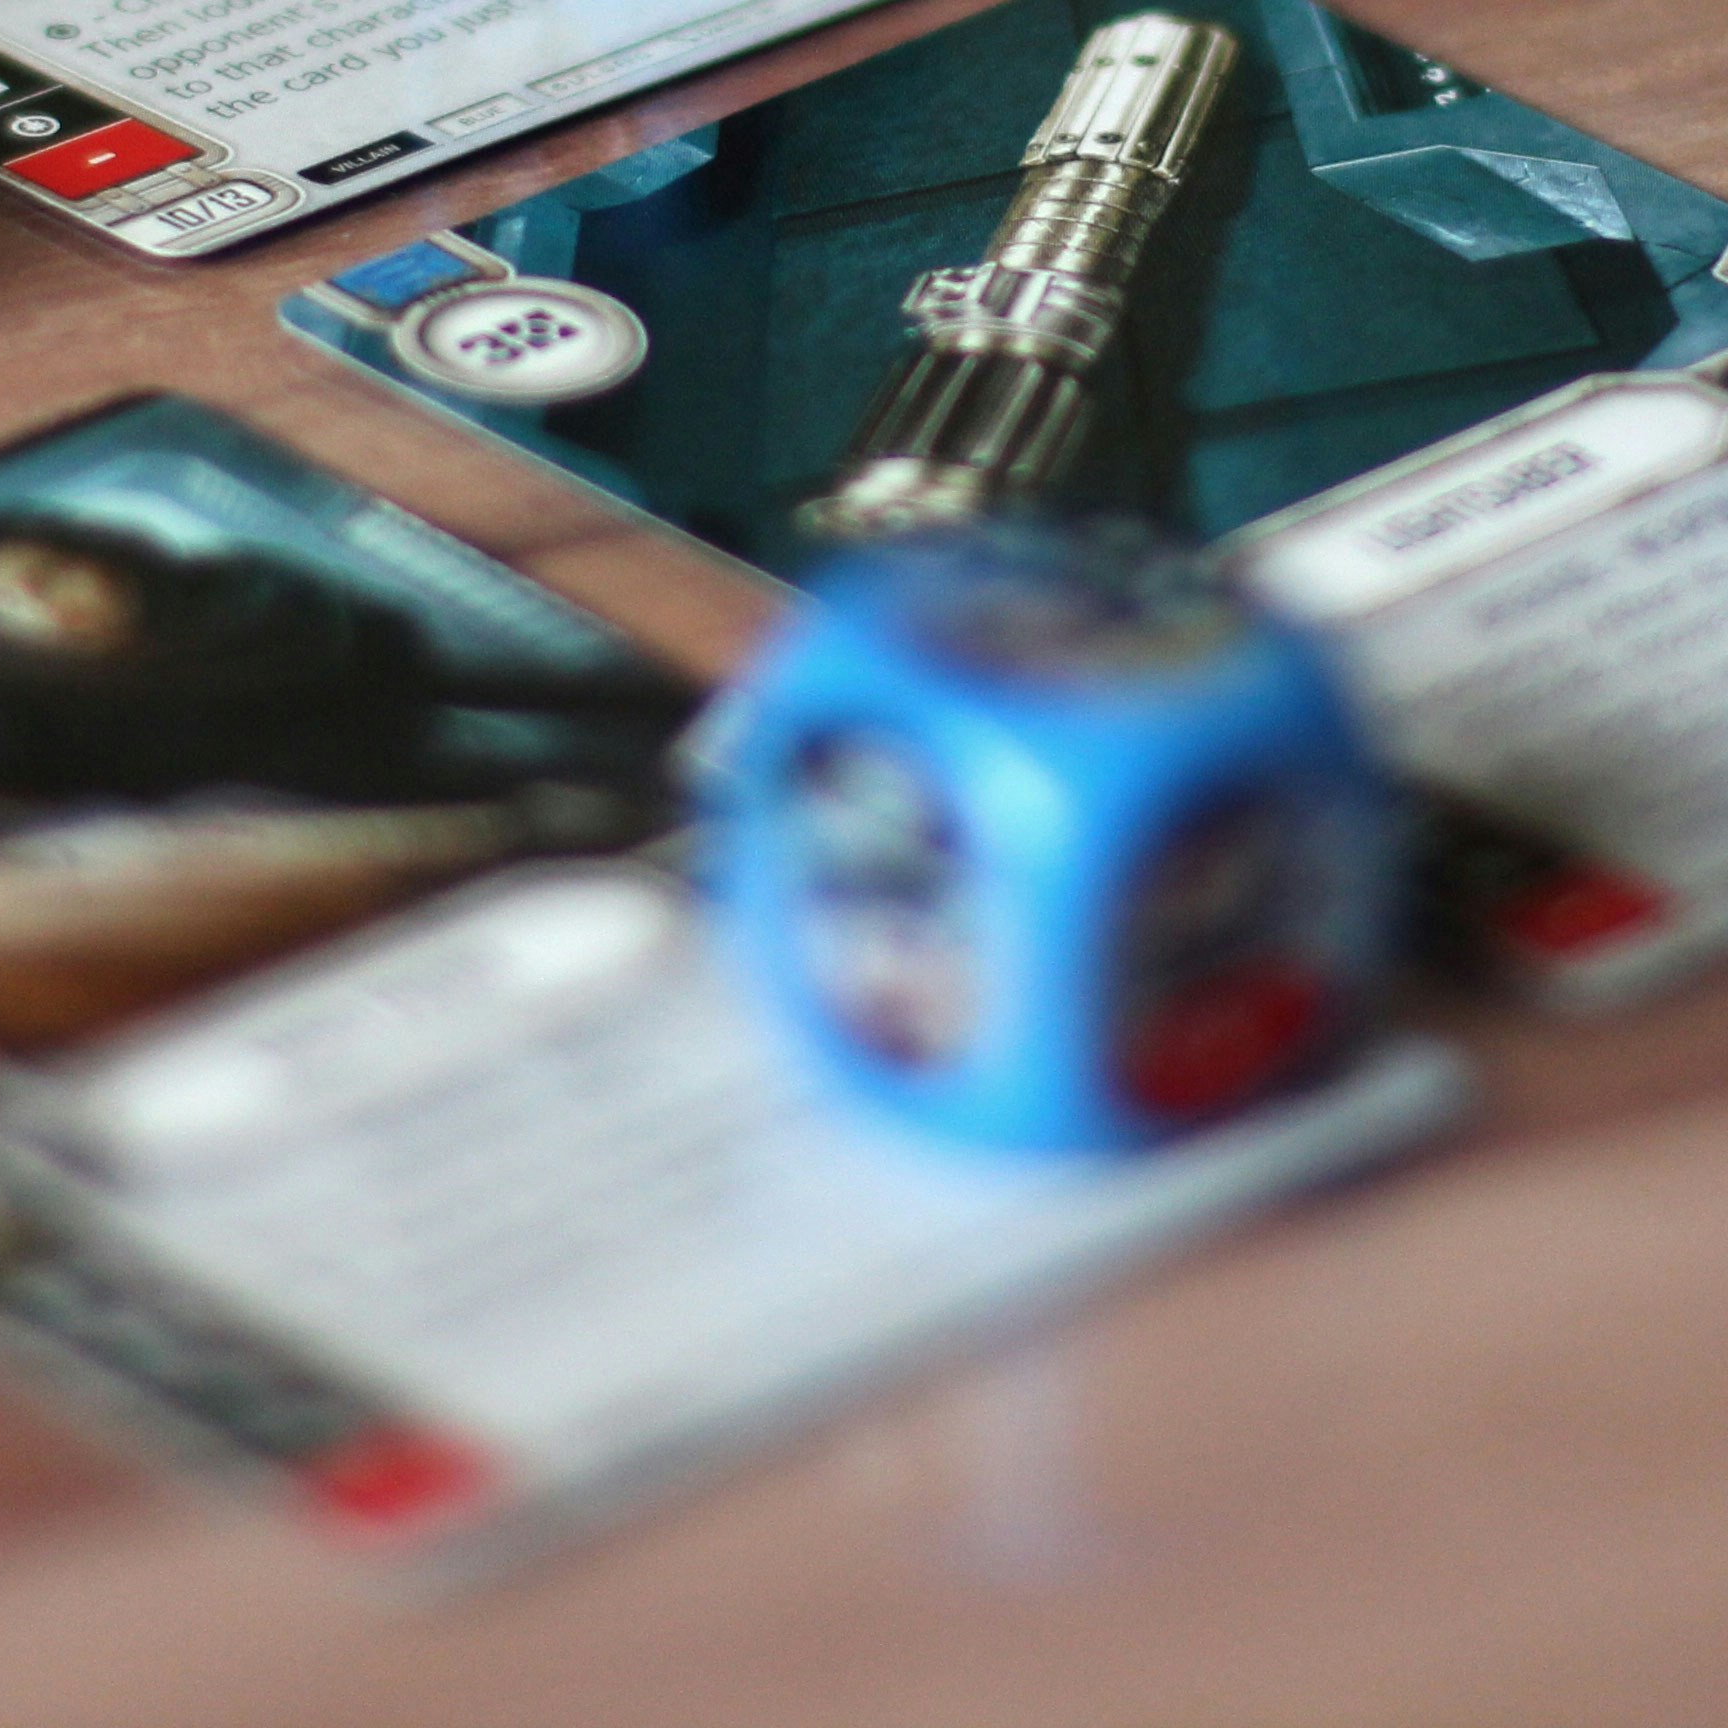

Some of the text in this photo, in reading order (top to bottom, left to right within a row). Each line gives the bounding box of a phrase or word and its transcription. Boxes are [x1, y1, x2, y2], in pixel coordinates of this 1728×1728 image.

[78, 20, 189, 60] Then
[164, 79, 214, 101] to
[213, 43, 307, 82] that
[205, 89, 279, 120] the
[283, 52, 369, 93] card
[372, 26, 448, 62] you
[457, 103, 504, 127] BLUE
[329, 142, 402, 175] VILLAIN
[155, 187, 260, 232] 10/13
[1376, 440, 1598, 551] LIGHTSABER
